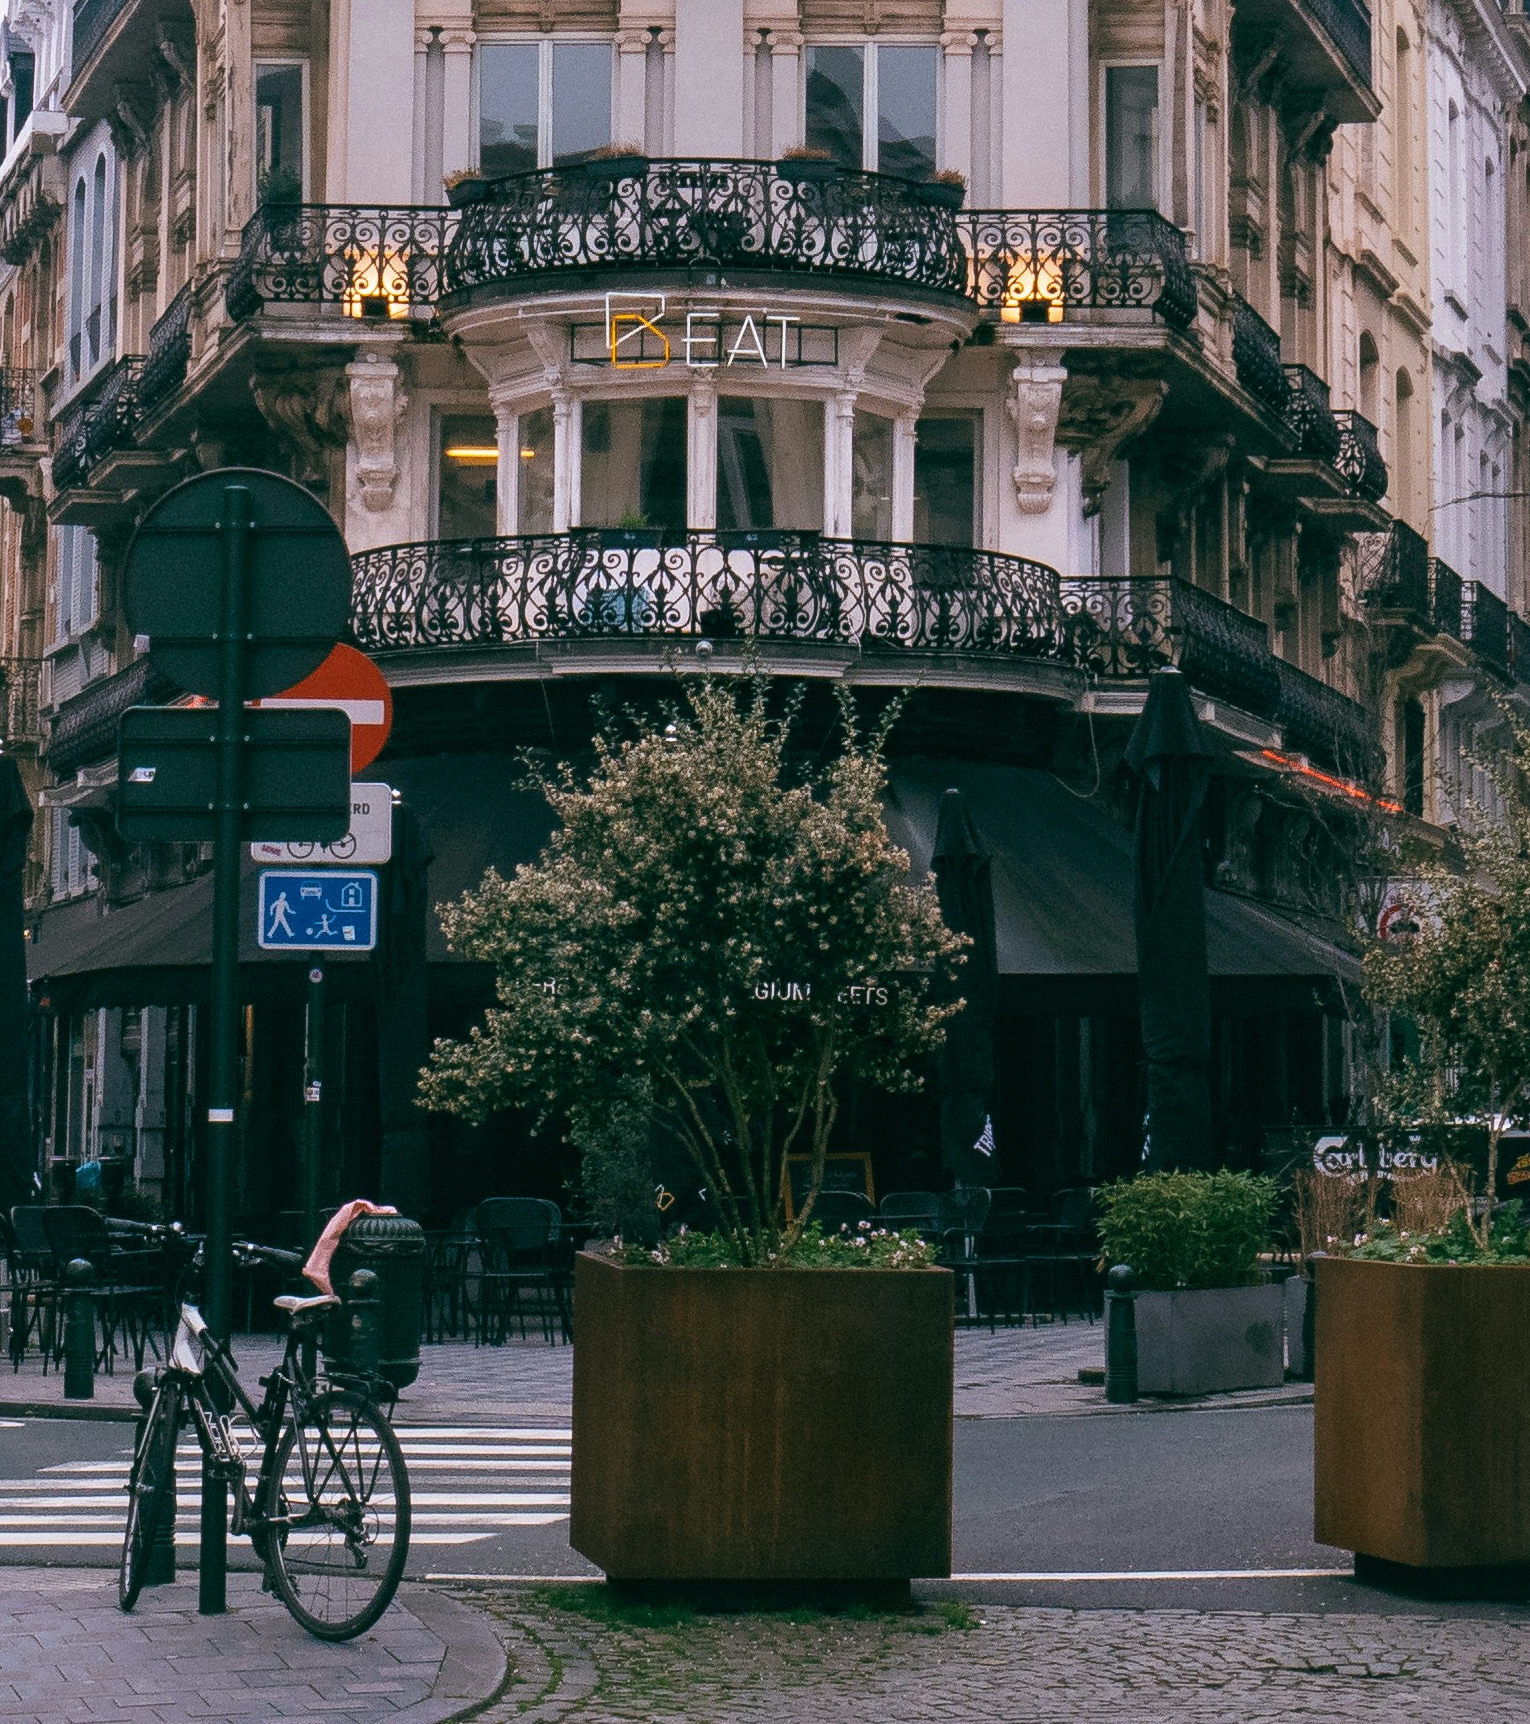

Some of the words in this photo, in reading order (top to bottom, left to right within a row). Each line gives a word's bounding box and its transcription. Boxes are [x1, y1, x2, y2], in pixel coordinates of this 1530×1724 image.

[605, 292, 801, 370] BEAT
[754, 981, 811, 1001] GIUM
[1312, 1135, 1438, 1177] Carlberg
